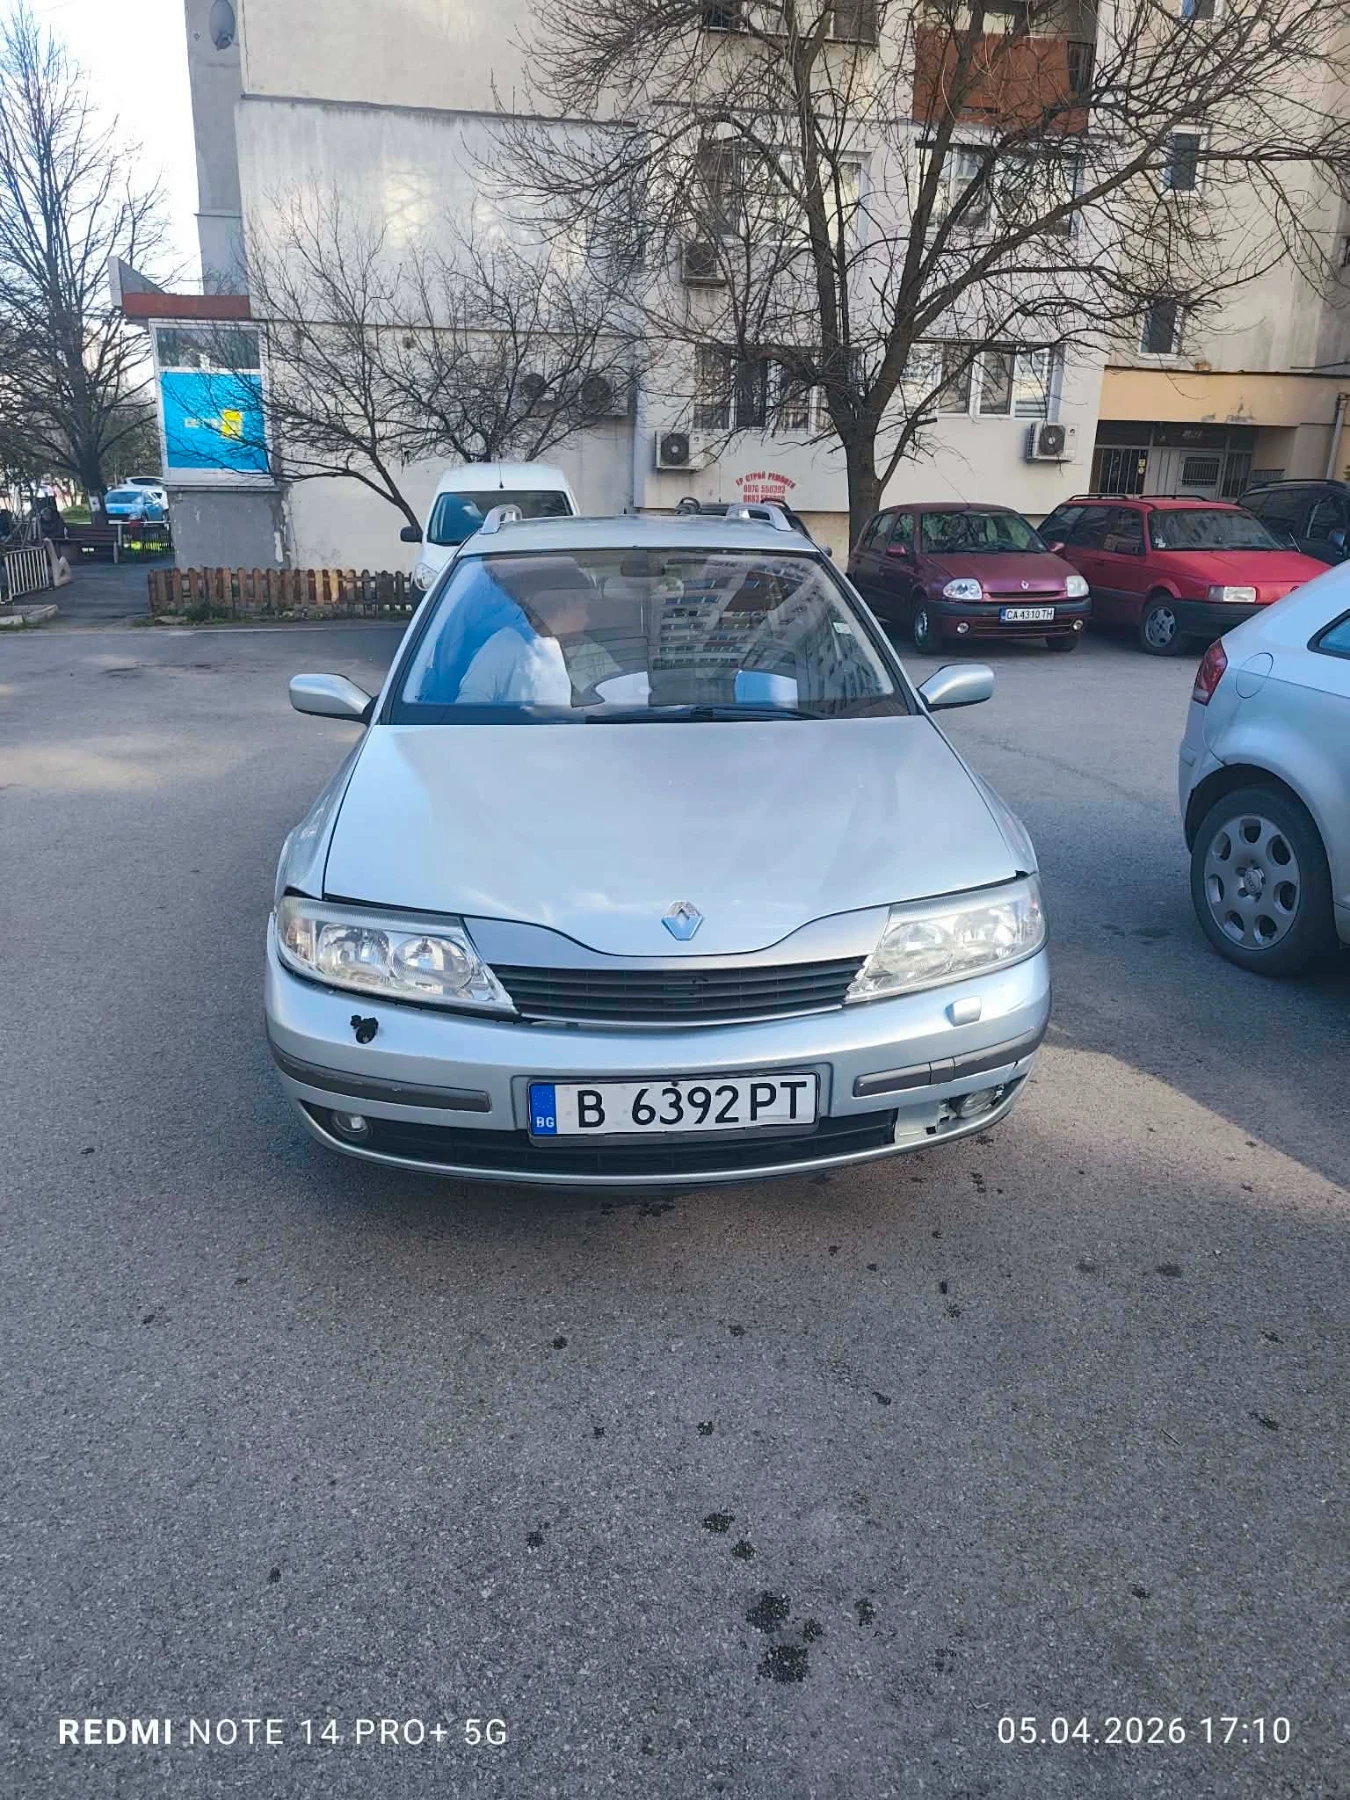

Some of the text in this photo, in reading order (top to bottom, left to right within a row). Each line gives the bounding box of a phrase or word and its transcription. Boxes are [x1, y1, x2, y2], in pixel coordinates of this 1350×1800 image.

[745, 470, 766, 482] СТРОЙ
[1006, 609, 1053, 620] CA 4310 TH
[577, 1080, 808, 1128] B 6392 PT
[535, 1116, 555, 1128] BG
